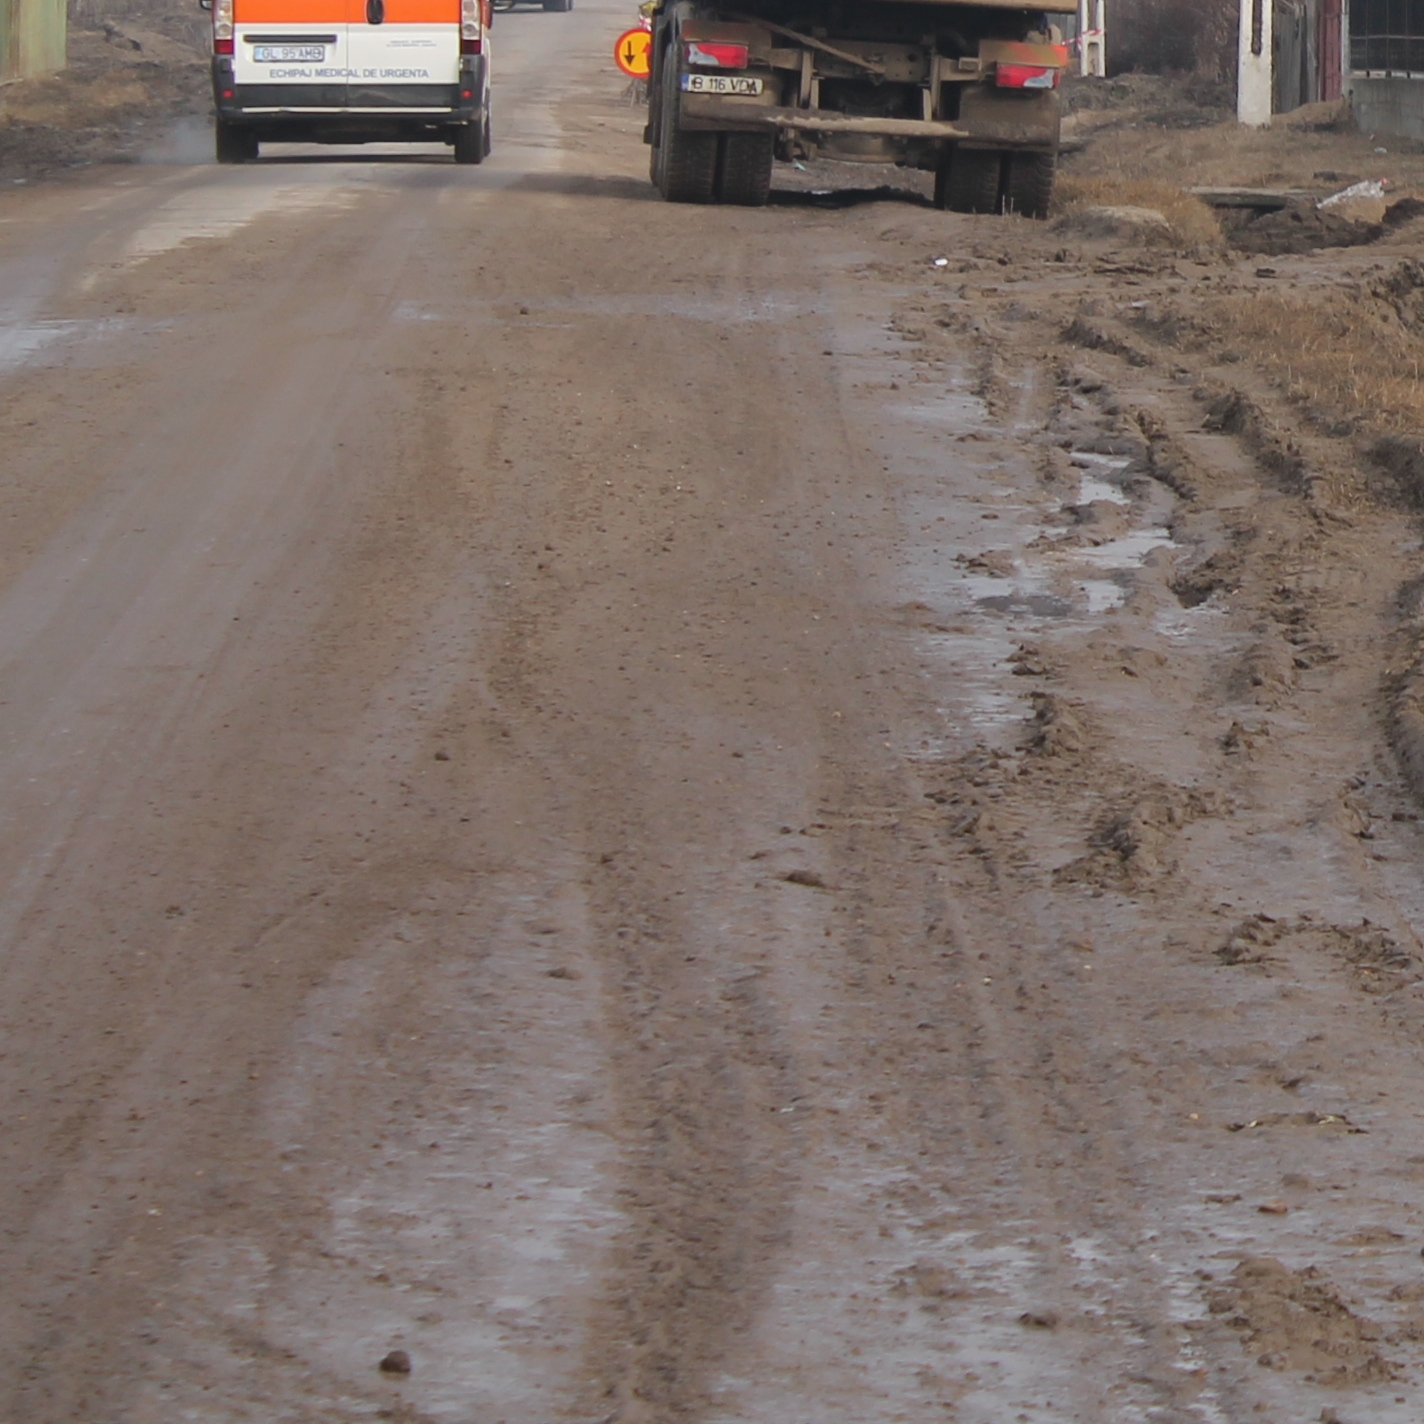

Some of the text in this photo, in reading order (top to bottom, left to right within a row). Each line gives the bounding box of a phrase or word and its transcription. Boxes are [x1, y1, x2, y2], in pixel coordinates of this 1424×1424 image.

[262, 48, 277, 59] GL
[282, 48, 295, 59] 95
[269, 68, 429, 78] ECHIPAJ MEDICAL DE URGENTA
[709, 78, 726, 90] 116
